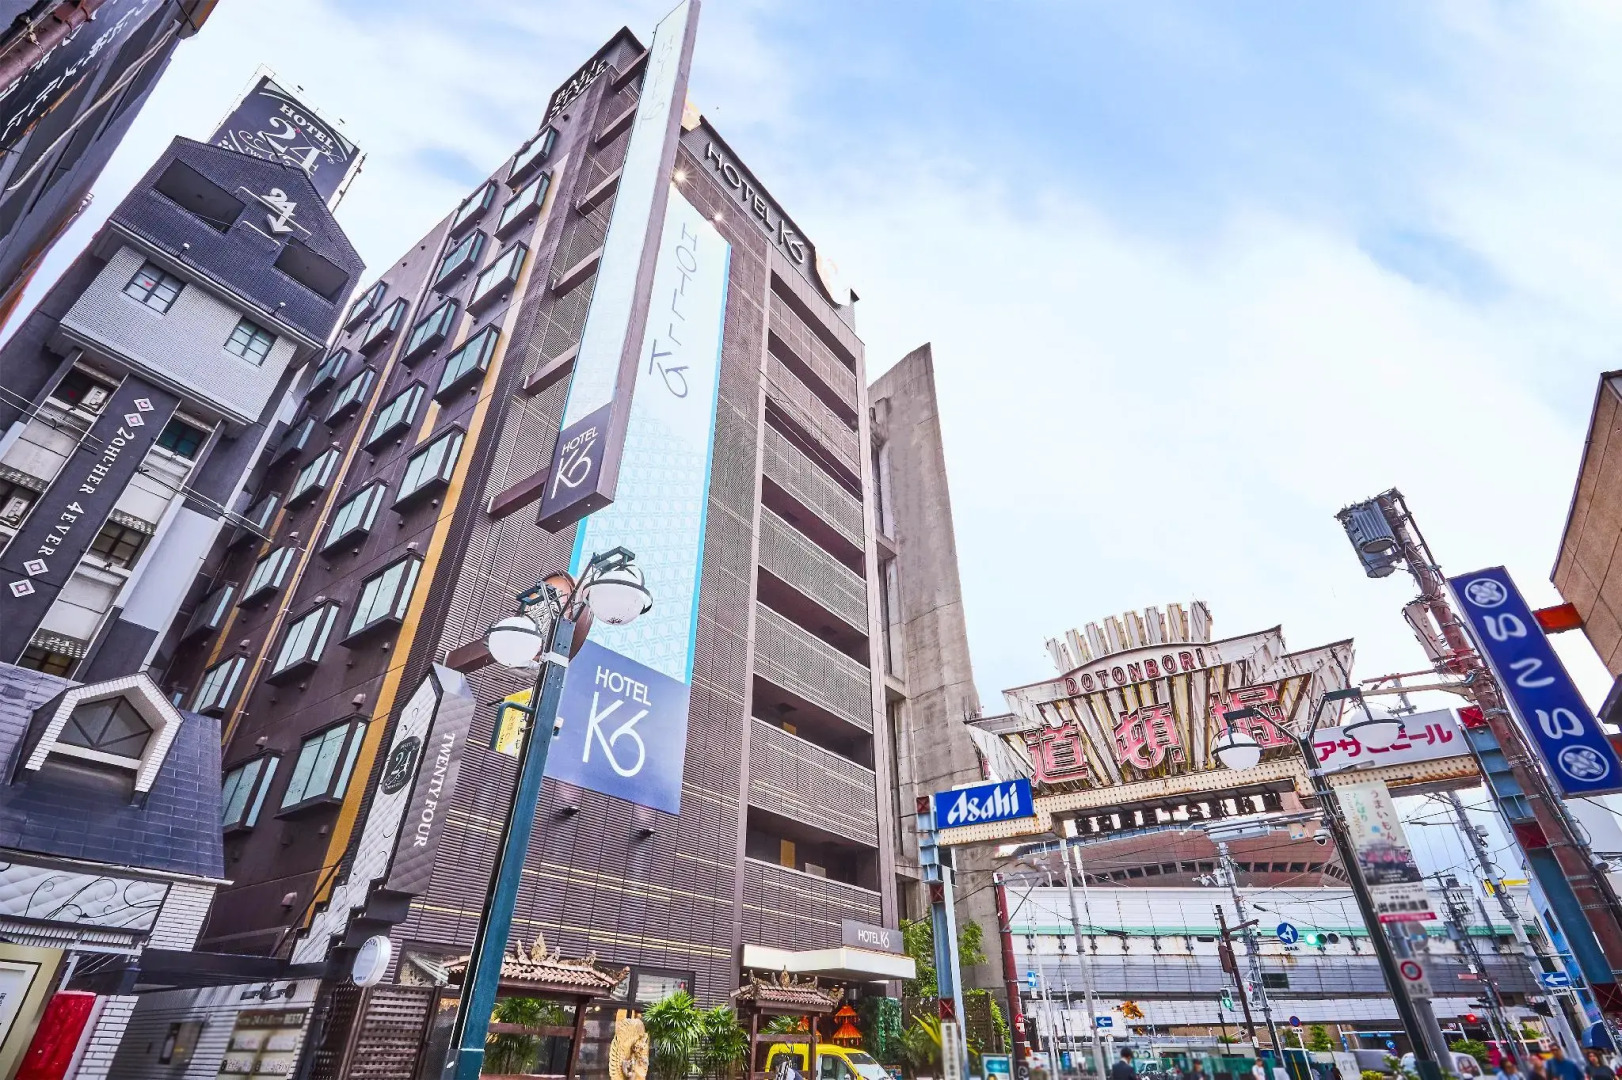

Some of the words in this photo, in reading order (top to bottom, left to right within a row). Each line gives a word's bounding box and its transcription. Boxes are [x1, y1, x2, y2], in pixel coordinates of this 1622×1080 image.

[257, 117, 319, 177] 24
[280, 104, 334, 149] HOTEL
[705, 141, 774, 232] HOTEL
[779, 219, 804, 264] K6
[561, 427, 598, 455] HOTEL
[551, 439, 596, 499] K6
[38, 501, 84, 556] 4EVER
[595, 665, 652, 706] HOTEL
[1065, 647, 1206, 696] DOTONBORI
[582, 691, 649, 777] K6
[1023, 684, 1294, 787] 道頓堀
[428, 733, 455, 798] TWENTY
[414, 799, 437, 847] FOUR
[947, 782, 1019, 825] Asahi
[858, 930, 880, 944] HOTEL
[880, 931, 890, 948] K6
